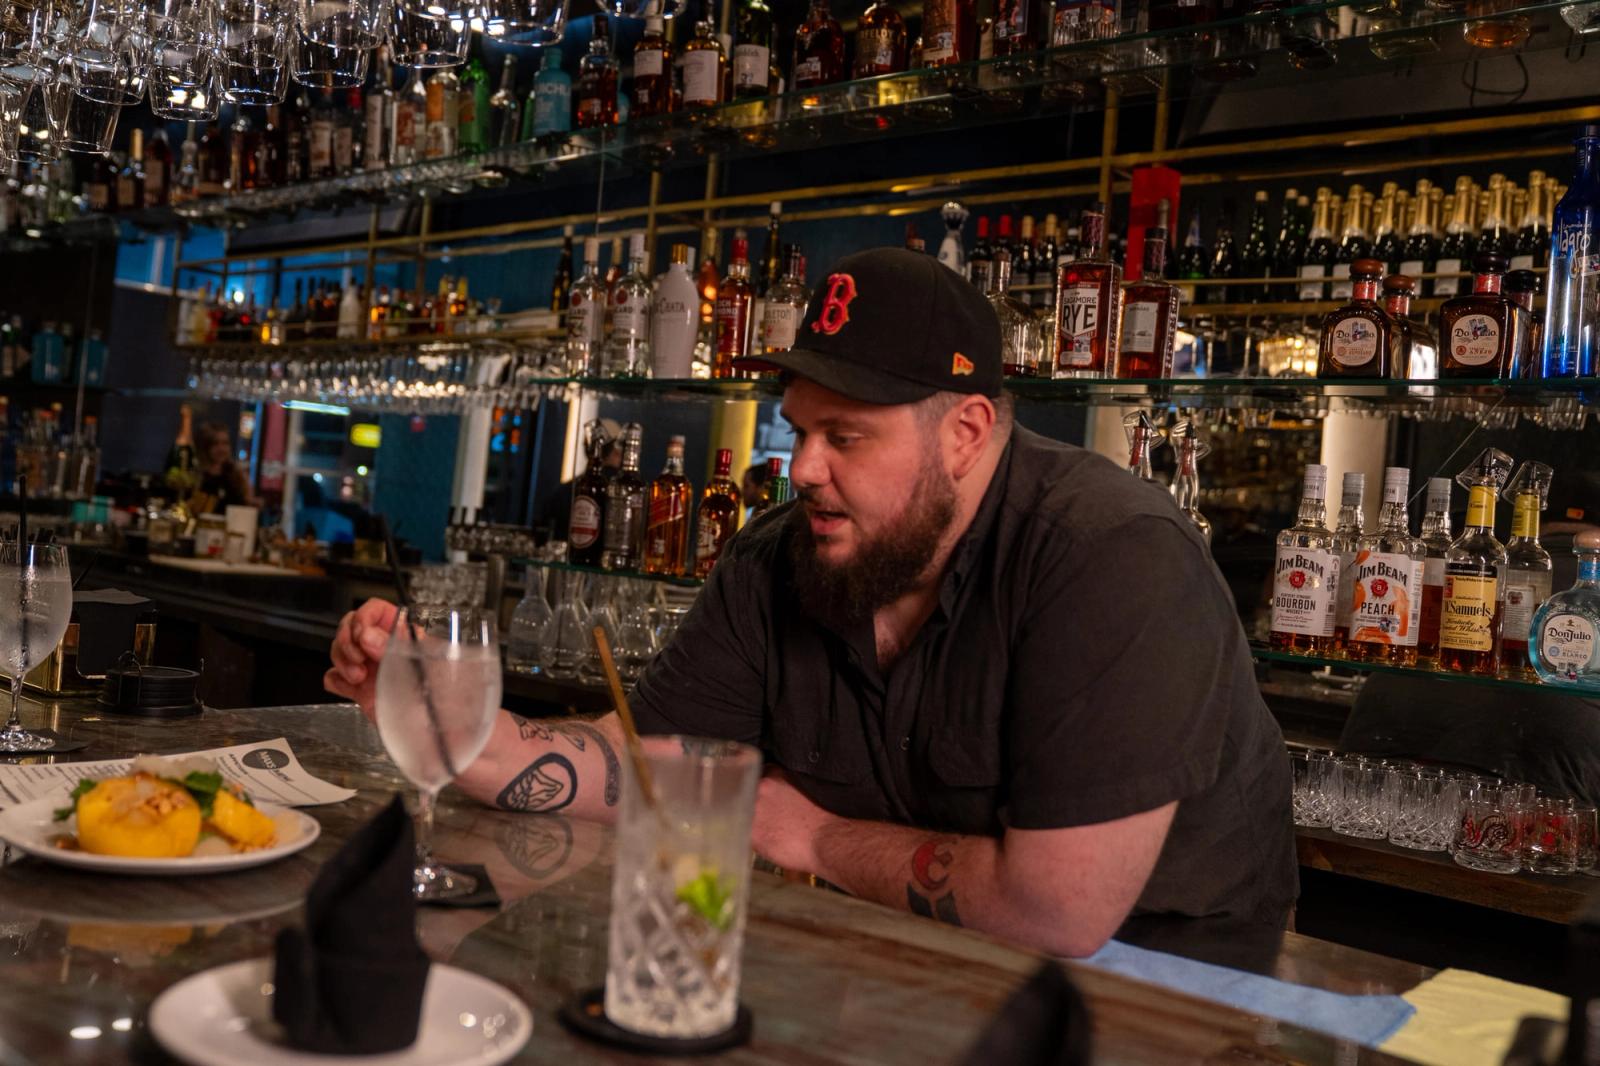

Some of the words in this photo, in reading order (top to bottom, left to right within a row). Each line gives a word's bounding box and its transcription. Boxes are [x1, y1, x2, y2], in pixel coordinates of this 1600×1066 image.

[811, 272, 858, 336] B
[1062, 304, 1097, 334] RYE
[1276, 557, 1295, 575] JIM
[1295, 554, 1324, 579] BEAM
[1356, 564, 1376, 582] JIM
[1377, 561, 1408, 586] BEAM
[1275, 596, 1317, 611] BOURBON
[1360, 602, 1395, 616] PEACH
